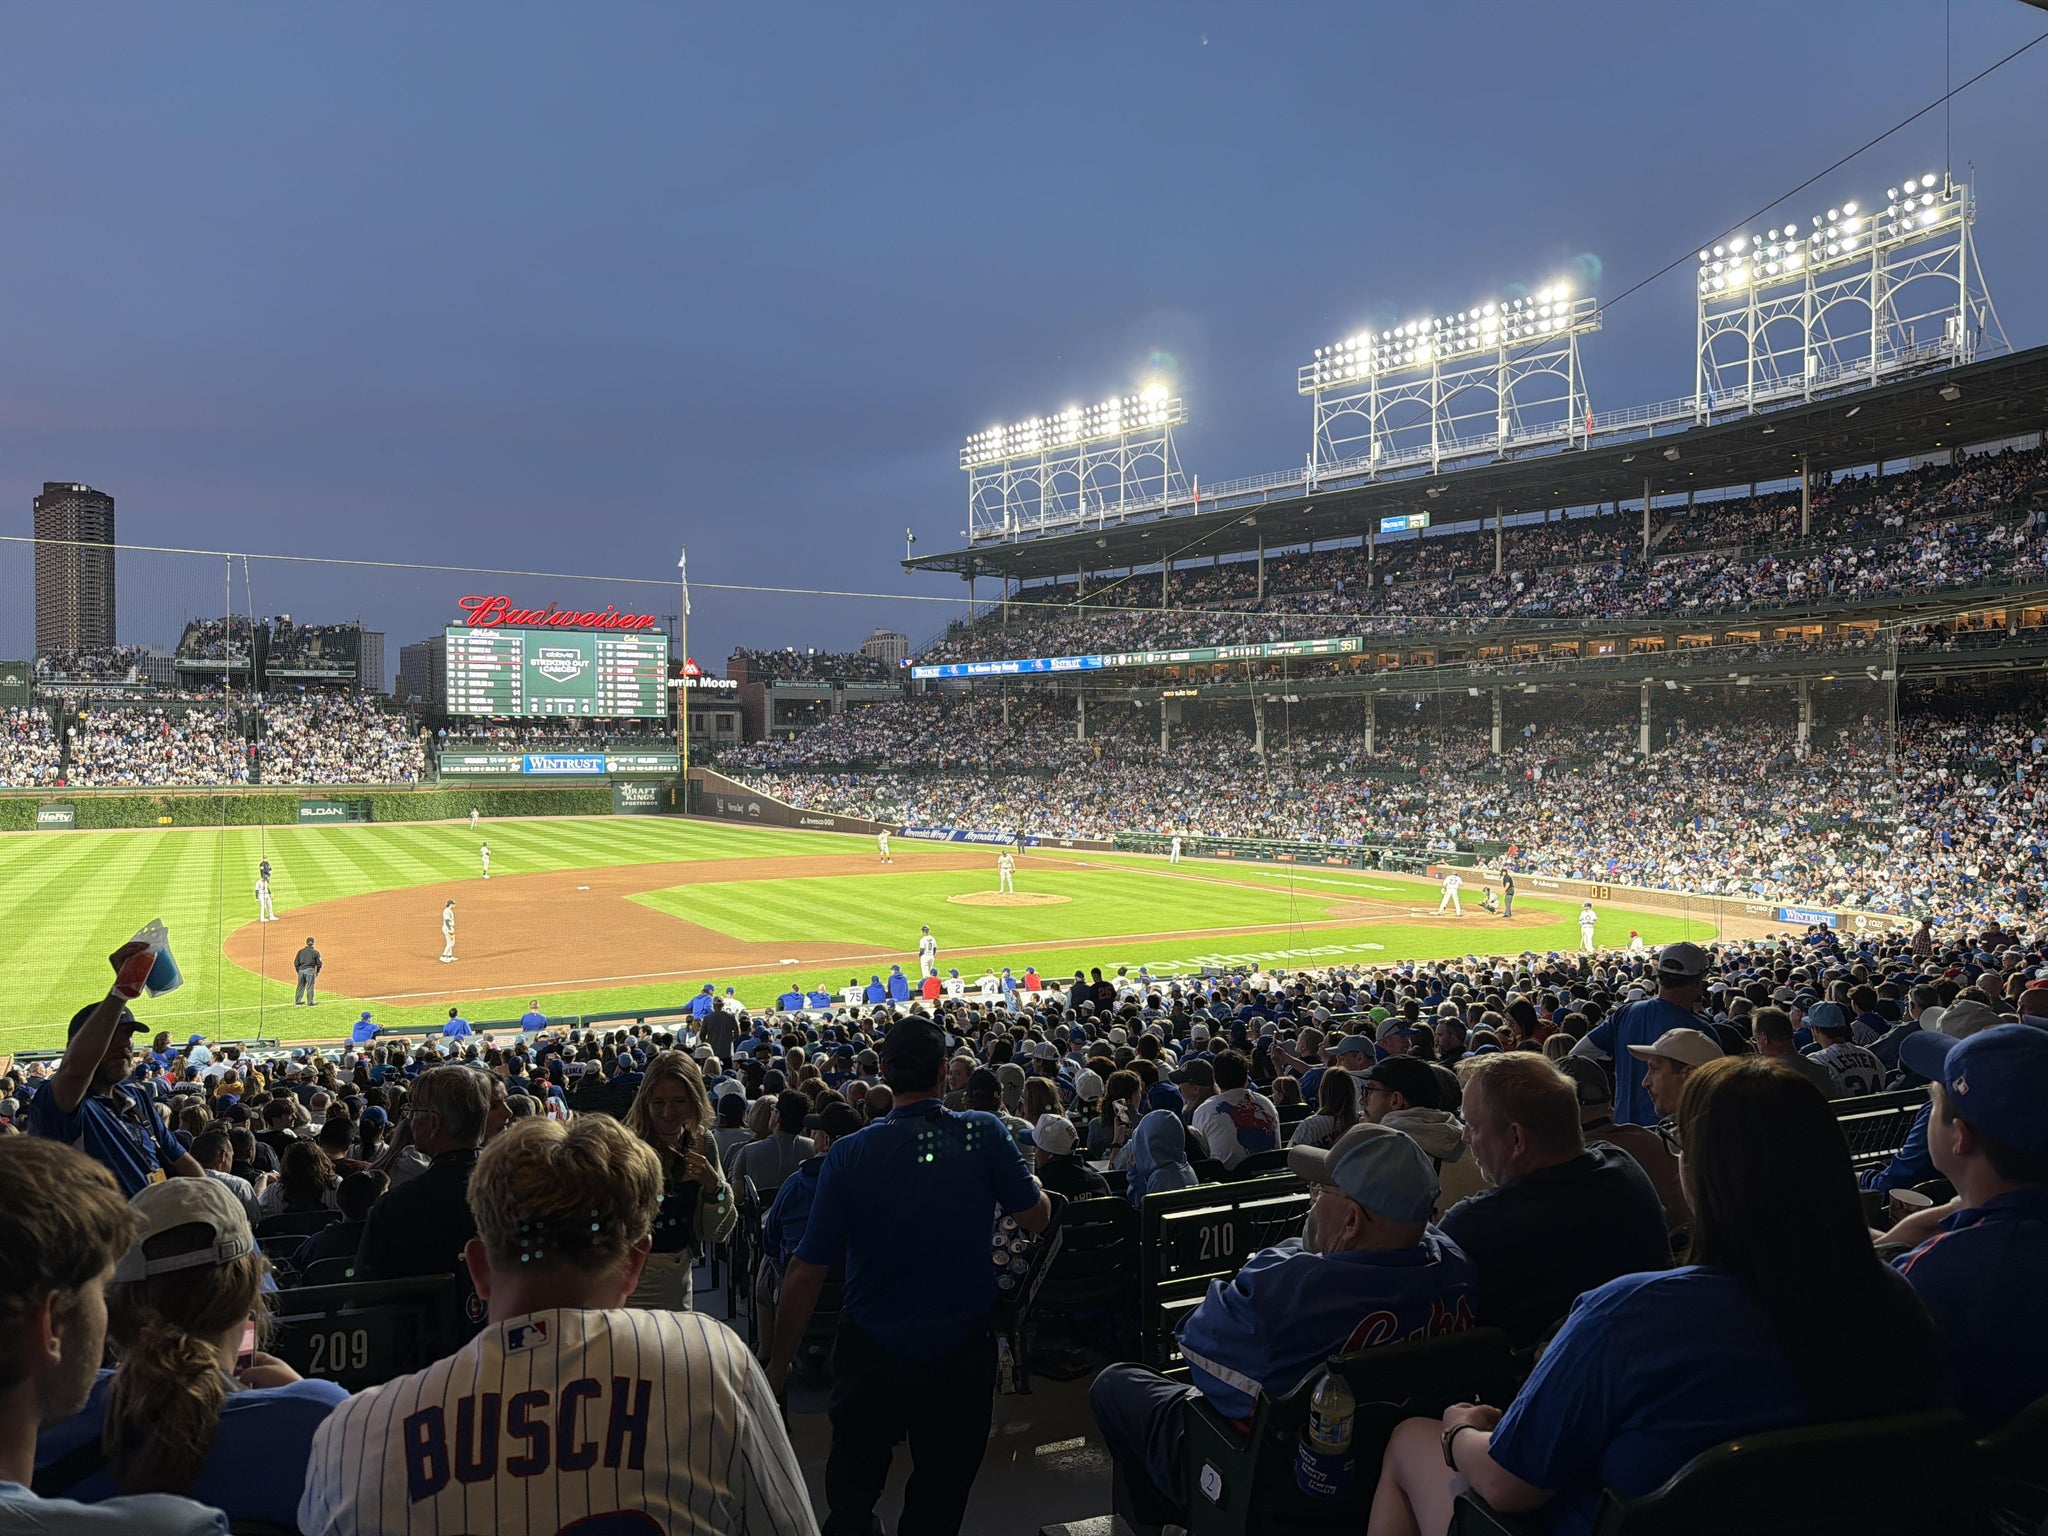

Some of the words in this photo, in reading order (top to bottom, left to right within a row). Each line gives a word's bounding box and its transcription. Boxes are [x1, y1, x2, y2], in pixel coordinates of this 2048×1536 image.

[459, 596, 655, 630] Budweiser
[667, 677, 697, 687] amin
[700, 677, 737, 688] Moore
[529, 756, 602, 768] WINTRUST
[621, 787, 656, 796] DRAFT
[40, 813, 71, 822] Hefty
[904, 828, 930, 839] Reynolds
[930, 828, 947, 841] Wrap
[963, 832, 995, 843] Reynolds
[994, 833, 1015, 844] Wrap
[1785, 909, 1834, 923] WINTRUST
[1104, 943, 1355, 974] Southwest
[955, 985, 960, 993] 2
[849, 992, 861, 1002] 75
[1829, 1053, 1878, 1073] LESTER
[1200, 1222, 1233, 1260] 210
[309, 1330, 367, 1374] 209
[400, 1376, 650, 1505] BUSCH
[1302, 1462, 1327, 1481] Hefty
[1206, 1472, 1214, 1492] 2
[1309, 1480, 1336, 1494] Hefty
